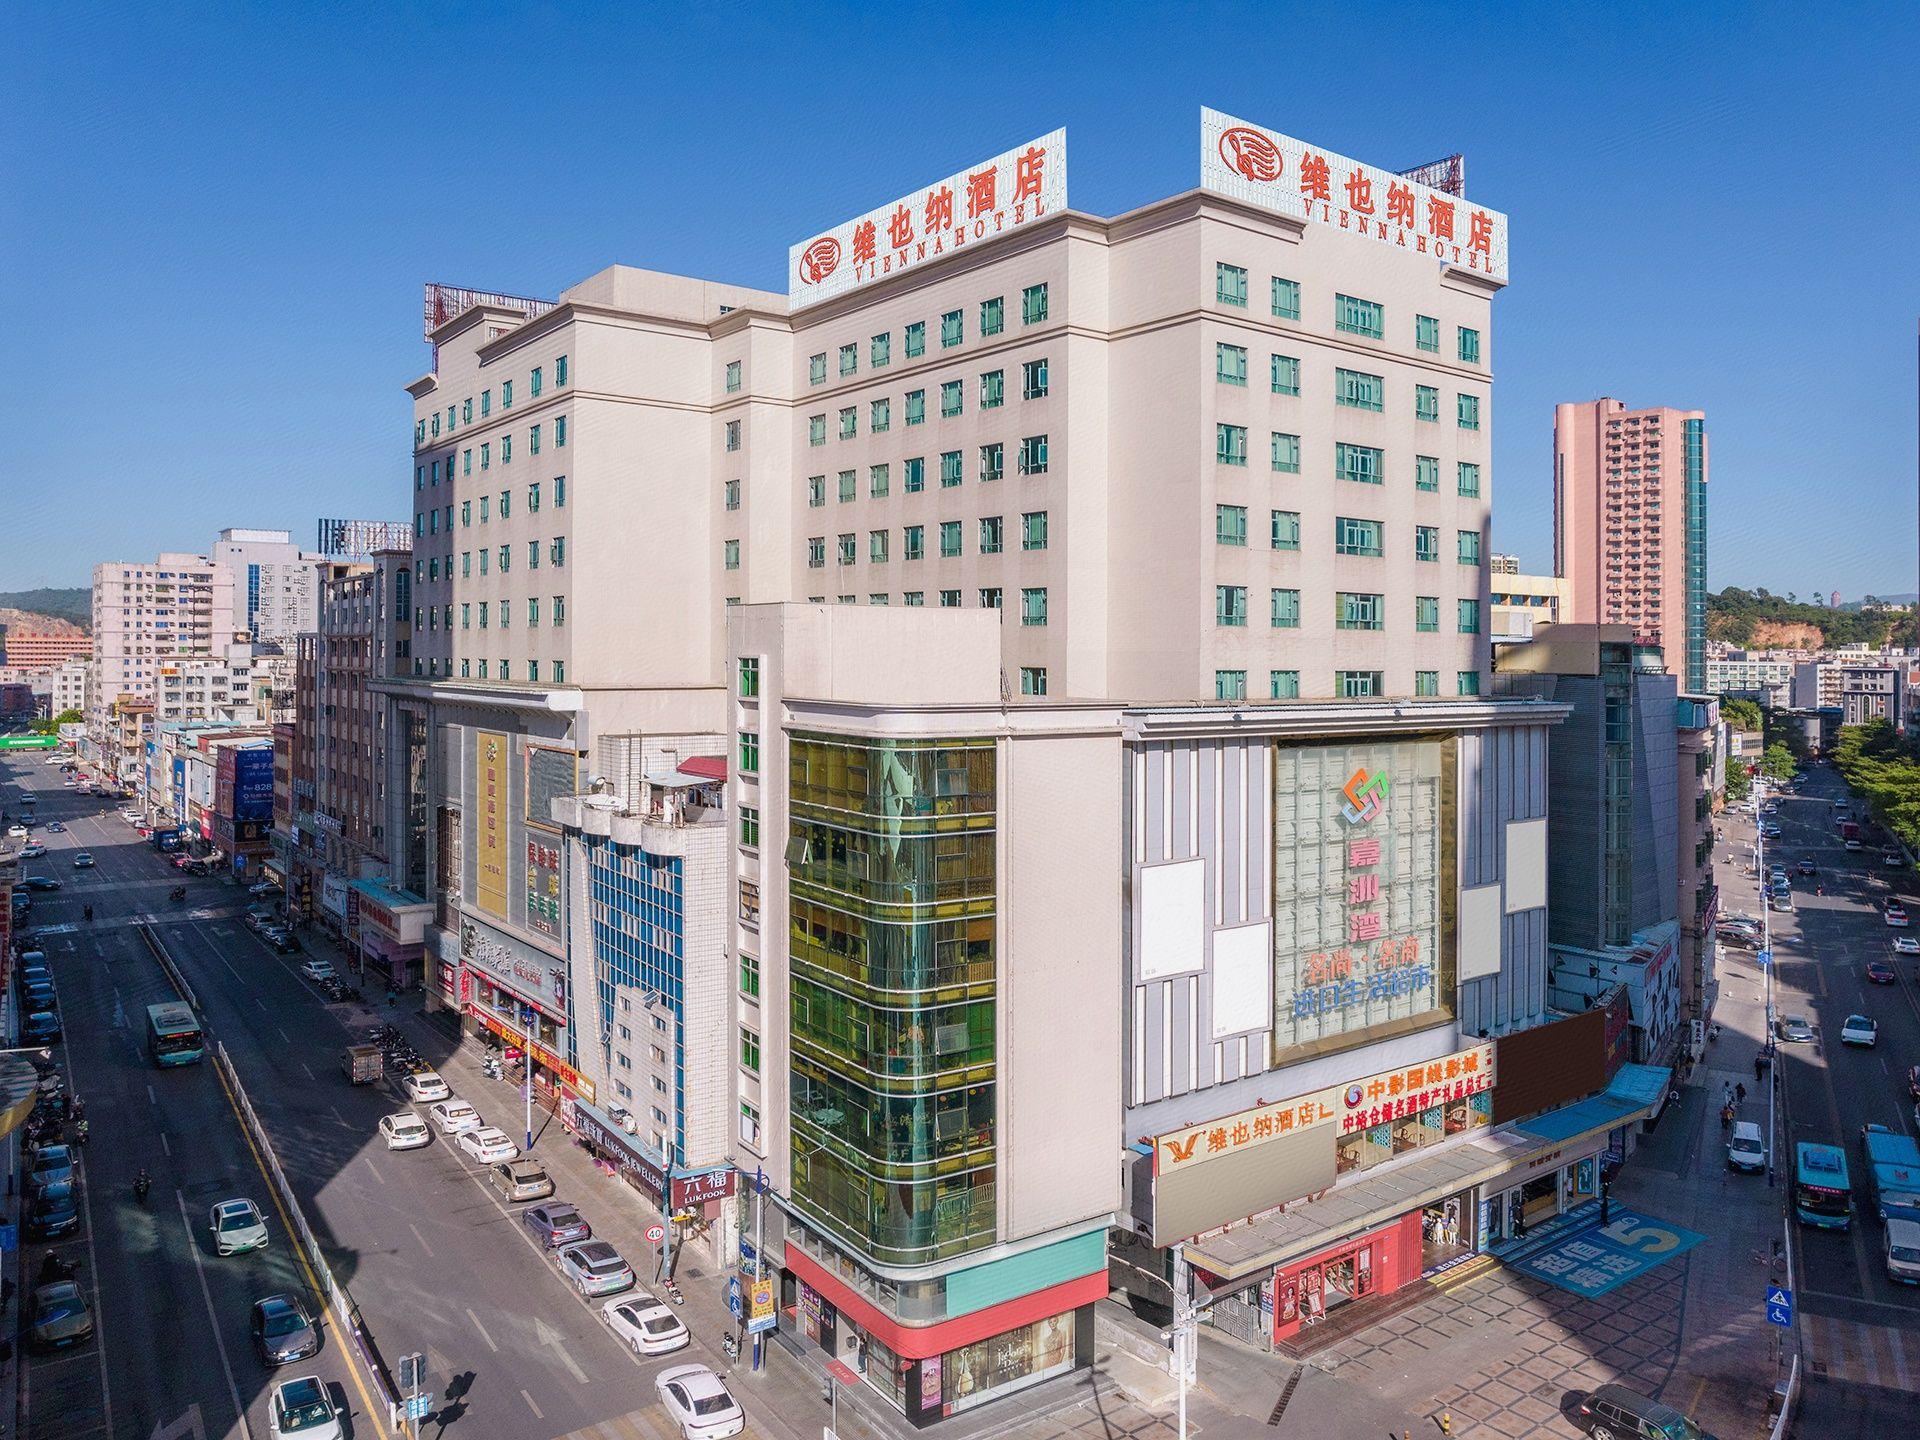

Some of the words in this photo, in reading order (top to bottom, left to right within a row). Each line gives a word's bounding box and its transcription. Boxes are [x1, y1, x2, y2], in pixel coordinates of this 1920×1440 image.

[853, 146, 1046, 265] 维也纳酒店
[1300, 151, 1493, 255] 维也纳酒店
[1303, 199, 1406, 247] VIENNA
[1416, 234, 1493, 273] HOTEL
[855, 237, 943, 283] VIENNA
[955, 198, 1046, 247] HOTEL
[1206, 1101, 1317, 1153] 维也纳酒店
[683, 1170, 727, 1195] 六福
[649, 1229, 661, 1239] 40
